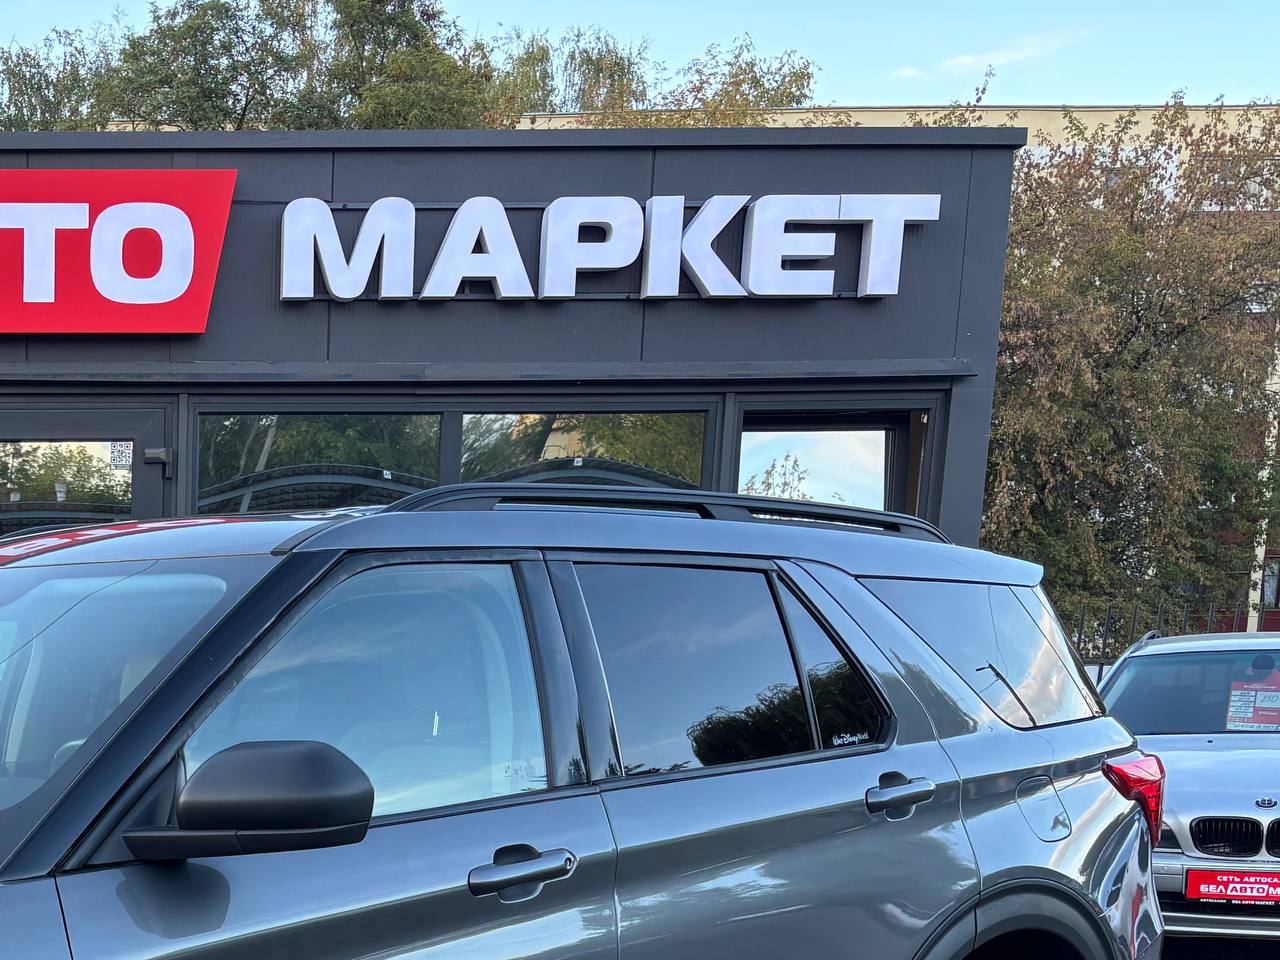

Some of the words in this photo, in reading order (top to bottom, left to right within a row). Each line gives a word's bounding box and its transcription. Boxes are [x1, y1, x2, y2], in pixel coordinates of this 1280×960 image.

[280, 193, 942, 303] МАРКЕТ
[1200, 884, 1226, 893] БЕЛ
[1229, 885, 1266, 894] АВТО
